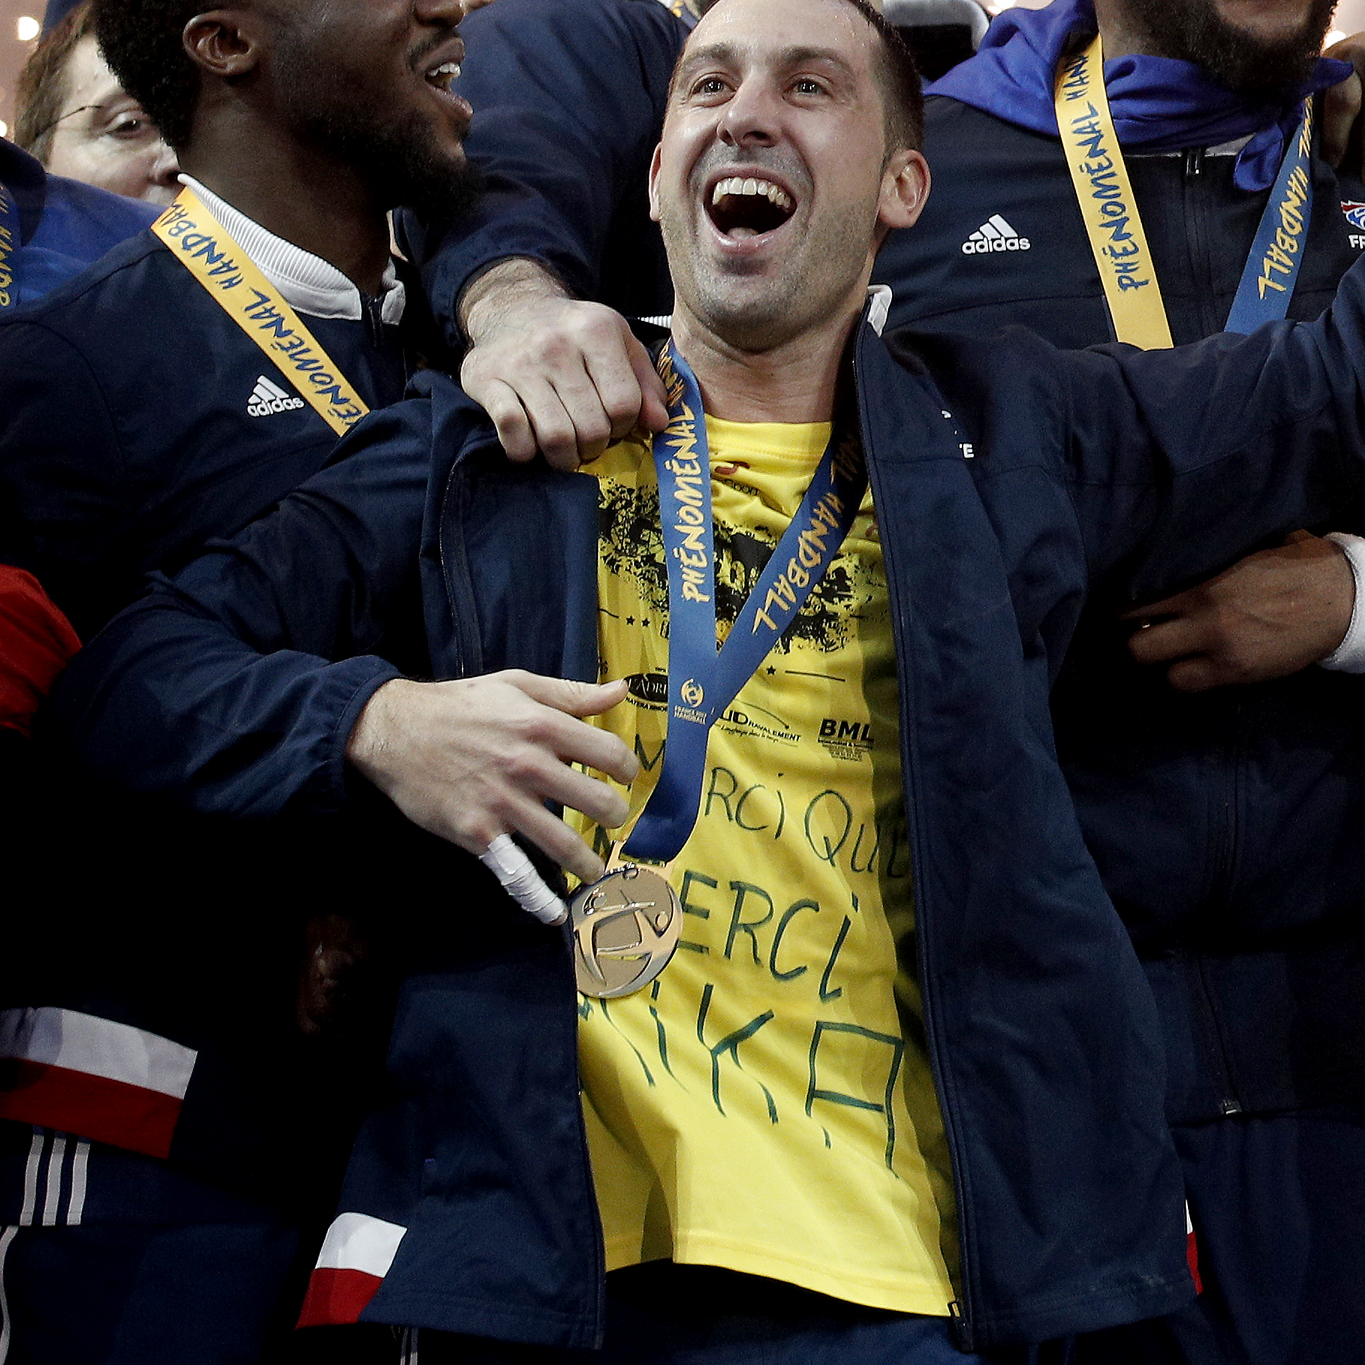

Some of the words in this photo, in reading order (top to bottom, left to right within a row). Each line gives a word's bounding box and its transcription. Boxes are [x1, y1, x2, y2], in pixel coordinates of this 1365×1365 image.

[962, 236, 1031, 254] adidas
[1257, 166, 1309, 300] HANDBALL
[243, 286, 363, 425] ÉNOMÉNAL
[247, 397, 305, 417] adidas
[752, 492, 845, 635] HANDBALL
[819, 718, 875, 744] BML
